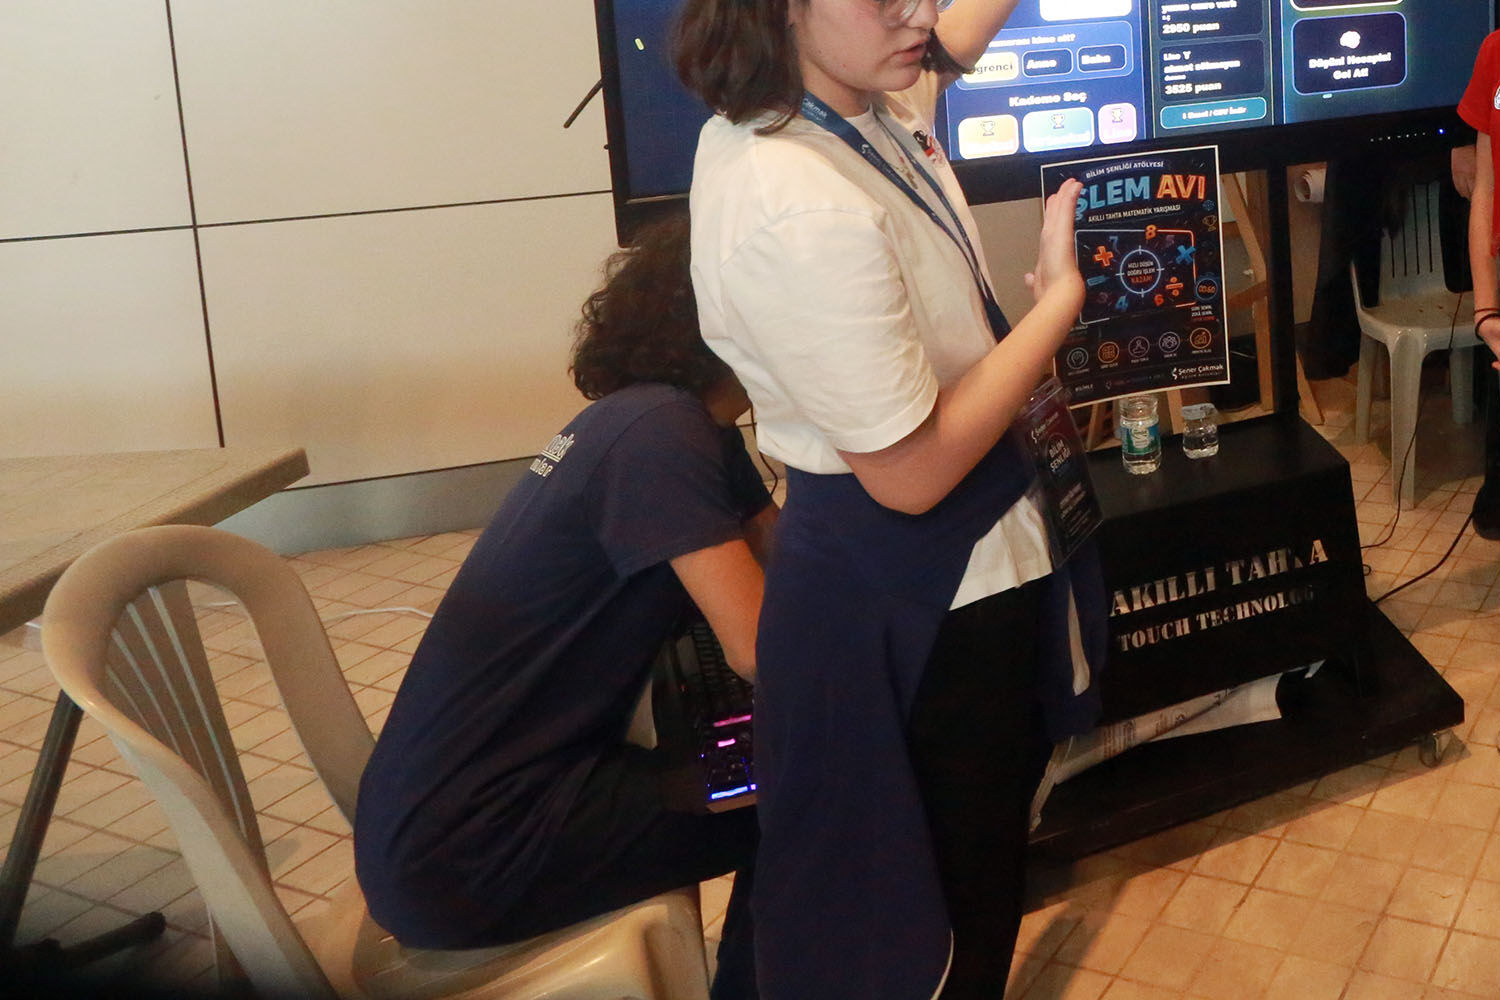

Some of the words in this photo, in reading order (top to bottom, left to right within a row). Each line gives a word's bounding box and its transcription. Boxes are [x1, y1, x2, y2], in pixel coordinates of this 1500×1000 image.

[1086, 168, 1105, 179] BİLİM
[1133, 160, 1164, 168] ATÖLYESİ
[1075, 175, 1150, 221] ŞLEM
[1156, 173, 1207, 200] AVI
[1110, 567, 1216, 617] AKILLI
[1225, 539, 1329, 586] TAHA
[1117, 616, 1192, 652] TOUCH
